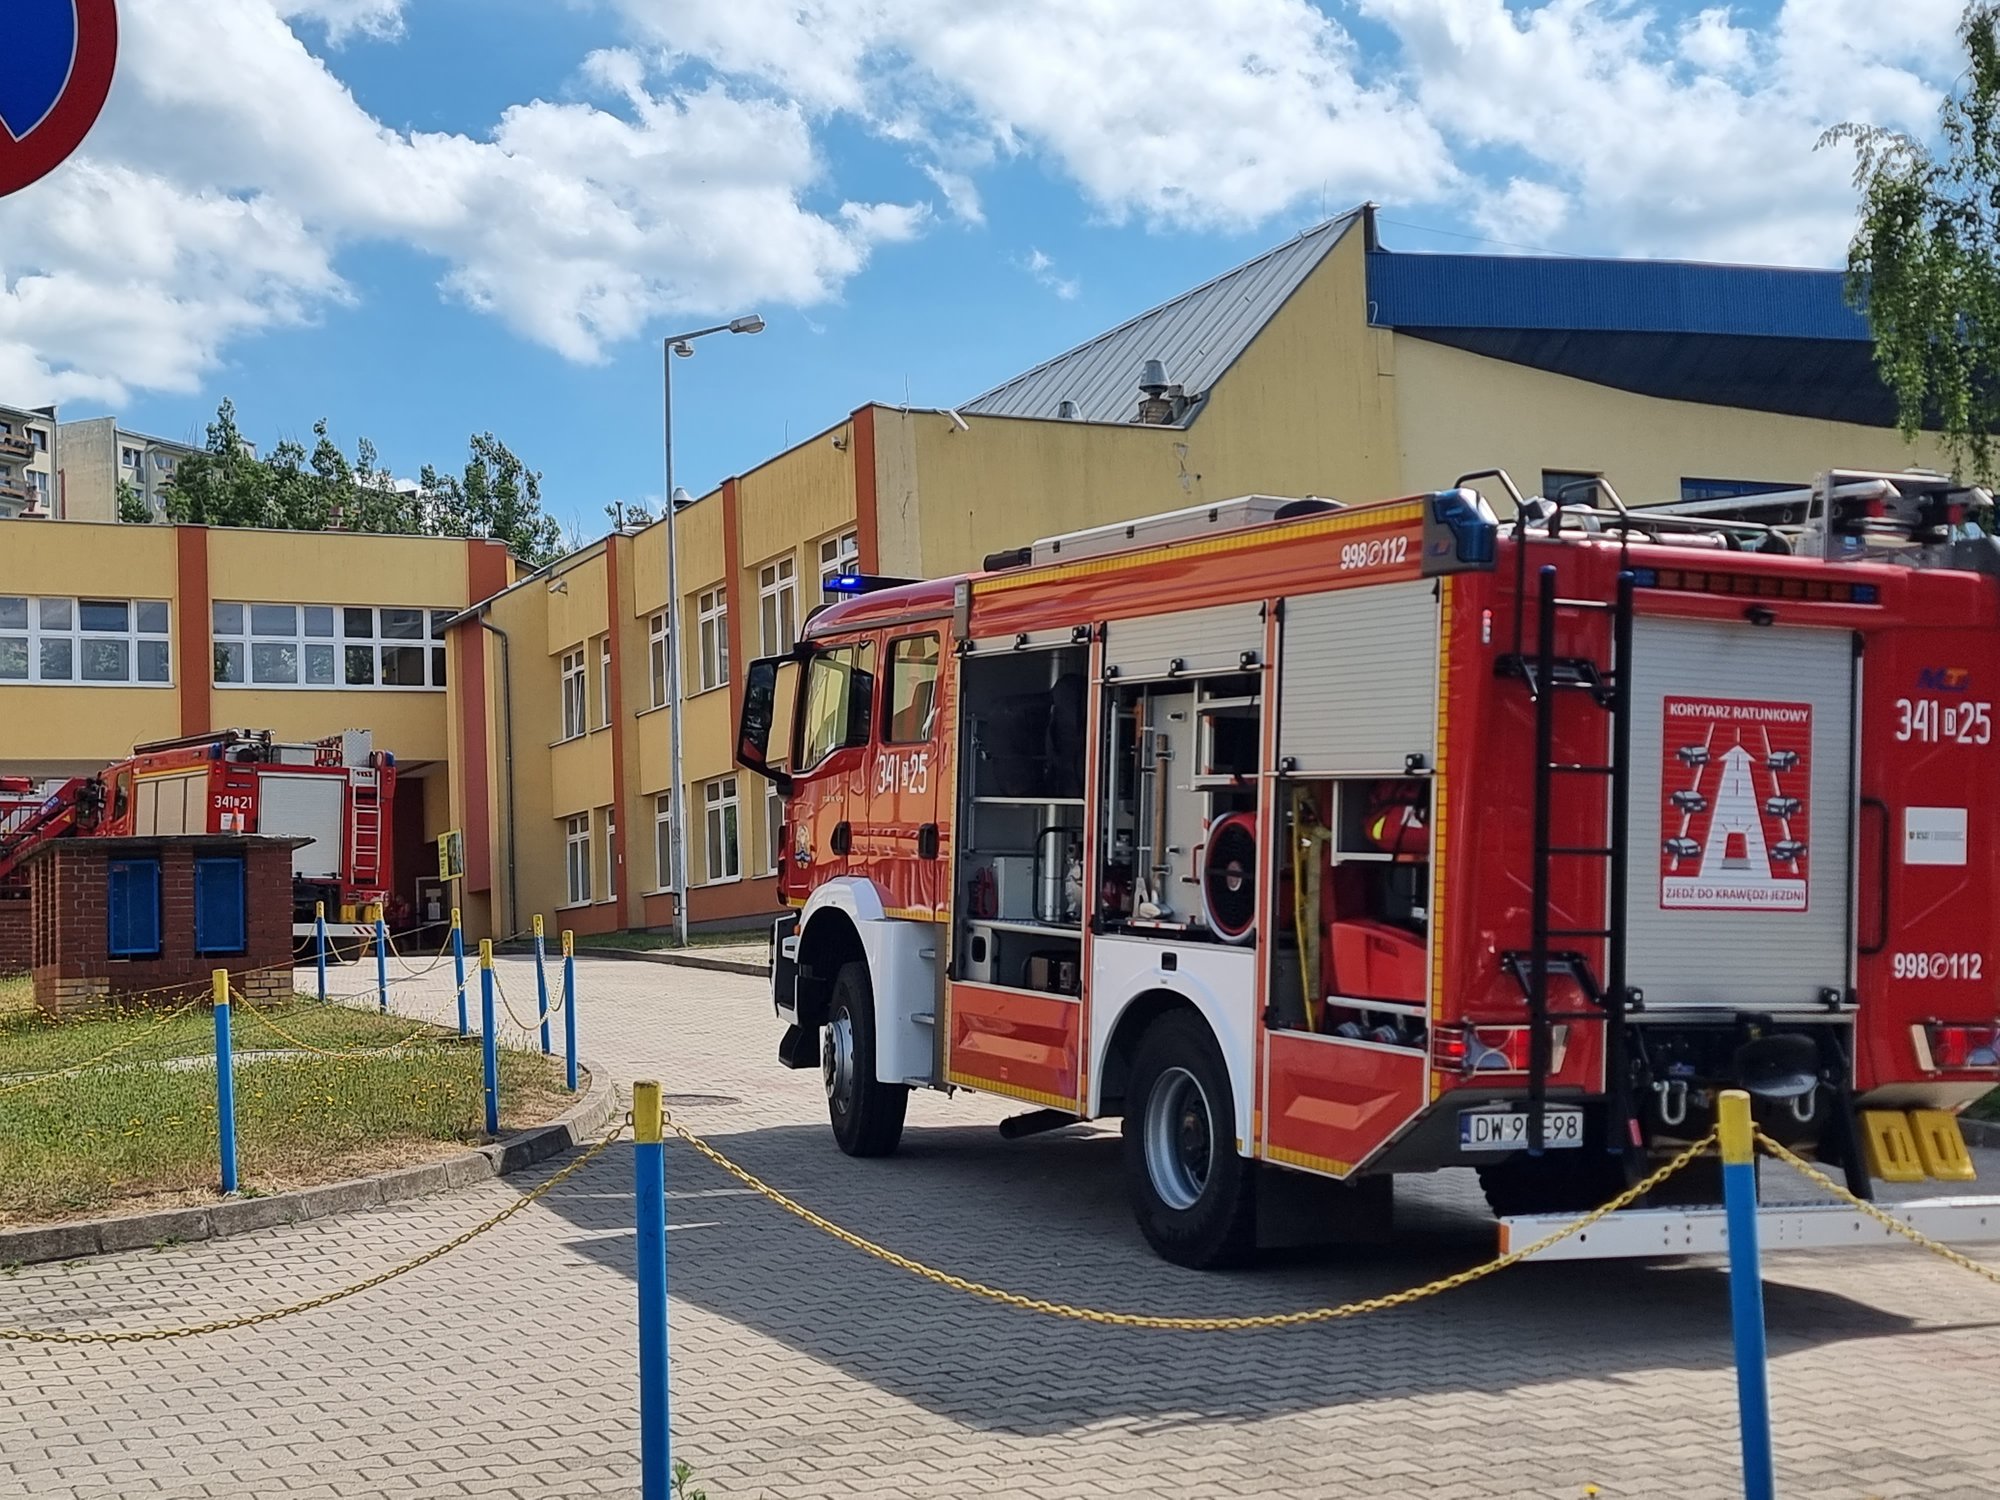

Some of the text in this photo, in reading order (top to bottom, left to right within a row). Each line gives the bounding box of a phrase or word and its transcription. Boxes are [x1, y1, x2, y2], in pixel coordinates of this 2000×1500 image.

[1340, 541, 1368, 570] 998
[1381, 535, 1408, 564] 112
[1670, 703, 1809, 722] KORYTARZ RATUNKOWY
[1895, 698, 1939, 743] 341
[1957, 701, 1992, 745] 25
[877, 754, 900, 794] 341
[909, 753, 929, 794] 25
[214, 795, 234, 809] 341
[240, 796, 252, 809] 21
[1665, 885, 1804, 902] ZJEDŹ DO KRAWĘDZI JEZDNI
[1894, 952, 1983, 980] 998 112
[1476, 1115, 1578, 1142] DW 9E98
